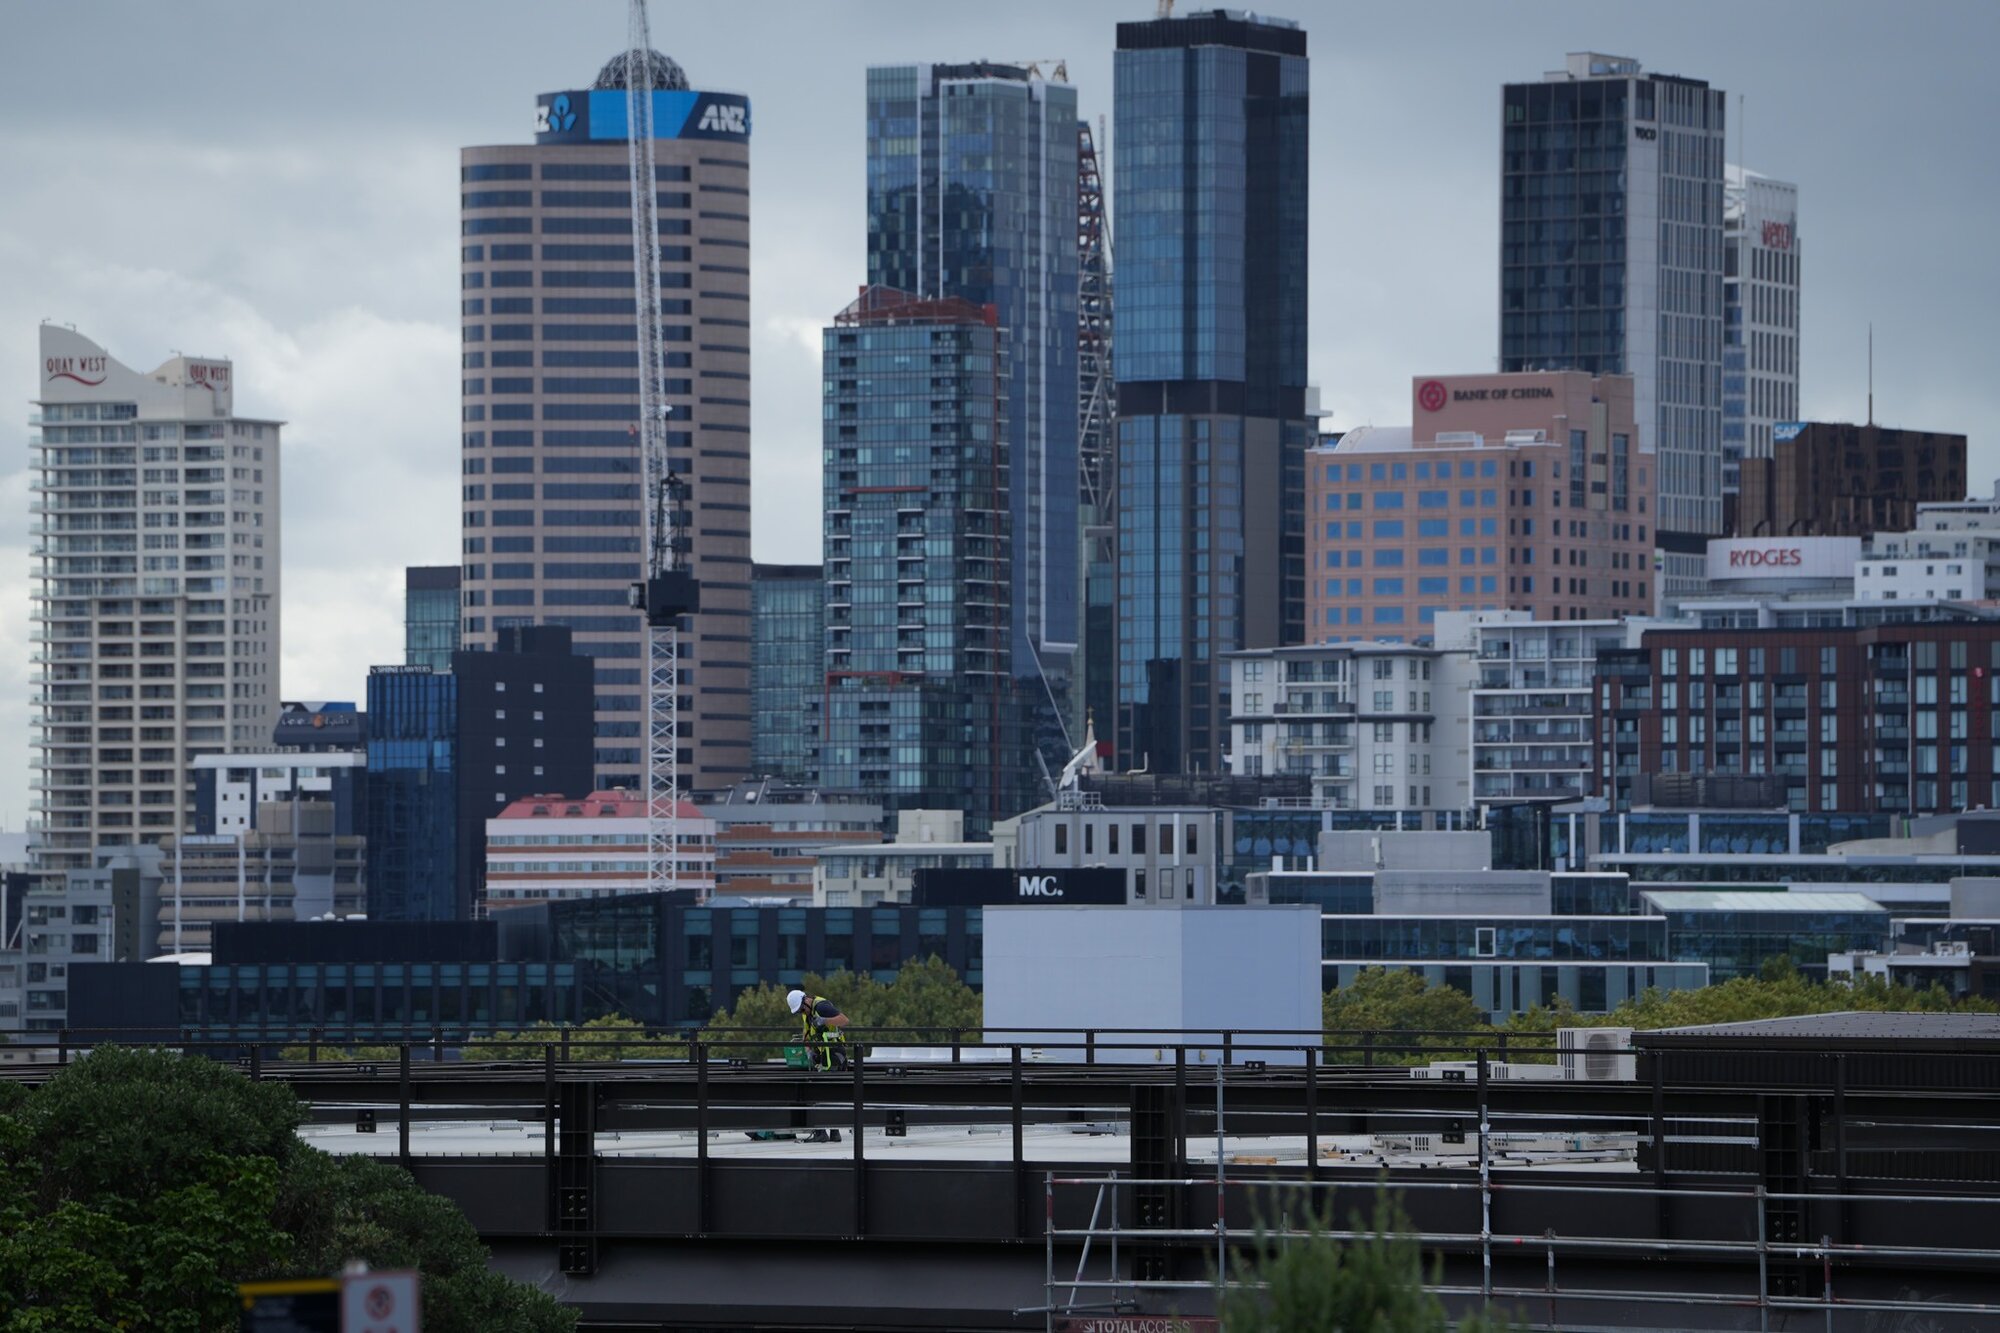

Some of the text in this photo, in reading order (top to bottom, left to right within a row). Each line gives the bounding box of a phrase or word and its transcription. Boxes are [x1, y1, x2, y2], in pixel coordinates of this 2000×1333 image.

[698, 104, 745, 134] ANZ
[47, 357, 106, 372] QUAY WEST
[1454, 387, 1554, 401] BANK OF CHINA
[1775, 425, 1799, 439] SAP
[1730, 549, 1802, 567] RYDGES
[1019, 875, 1064, 896] MC.
